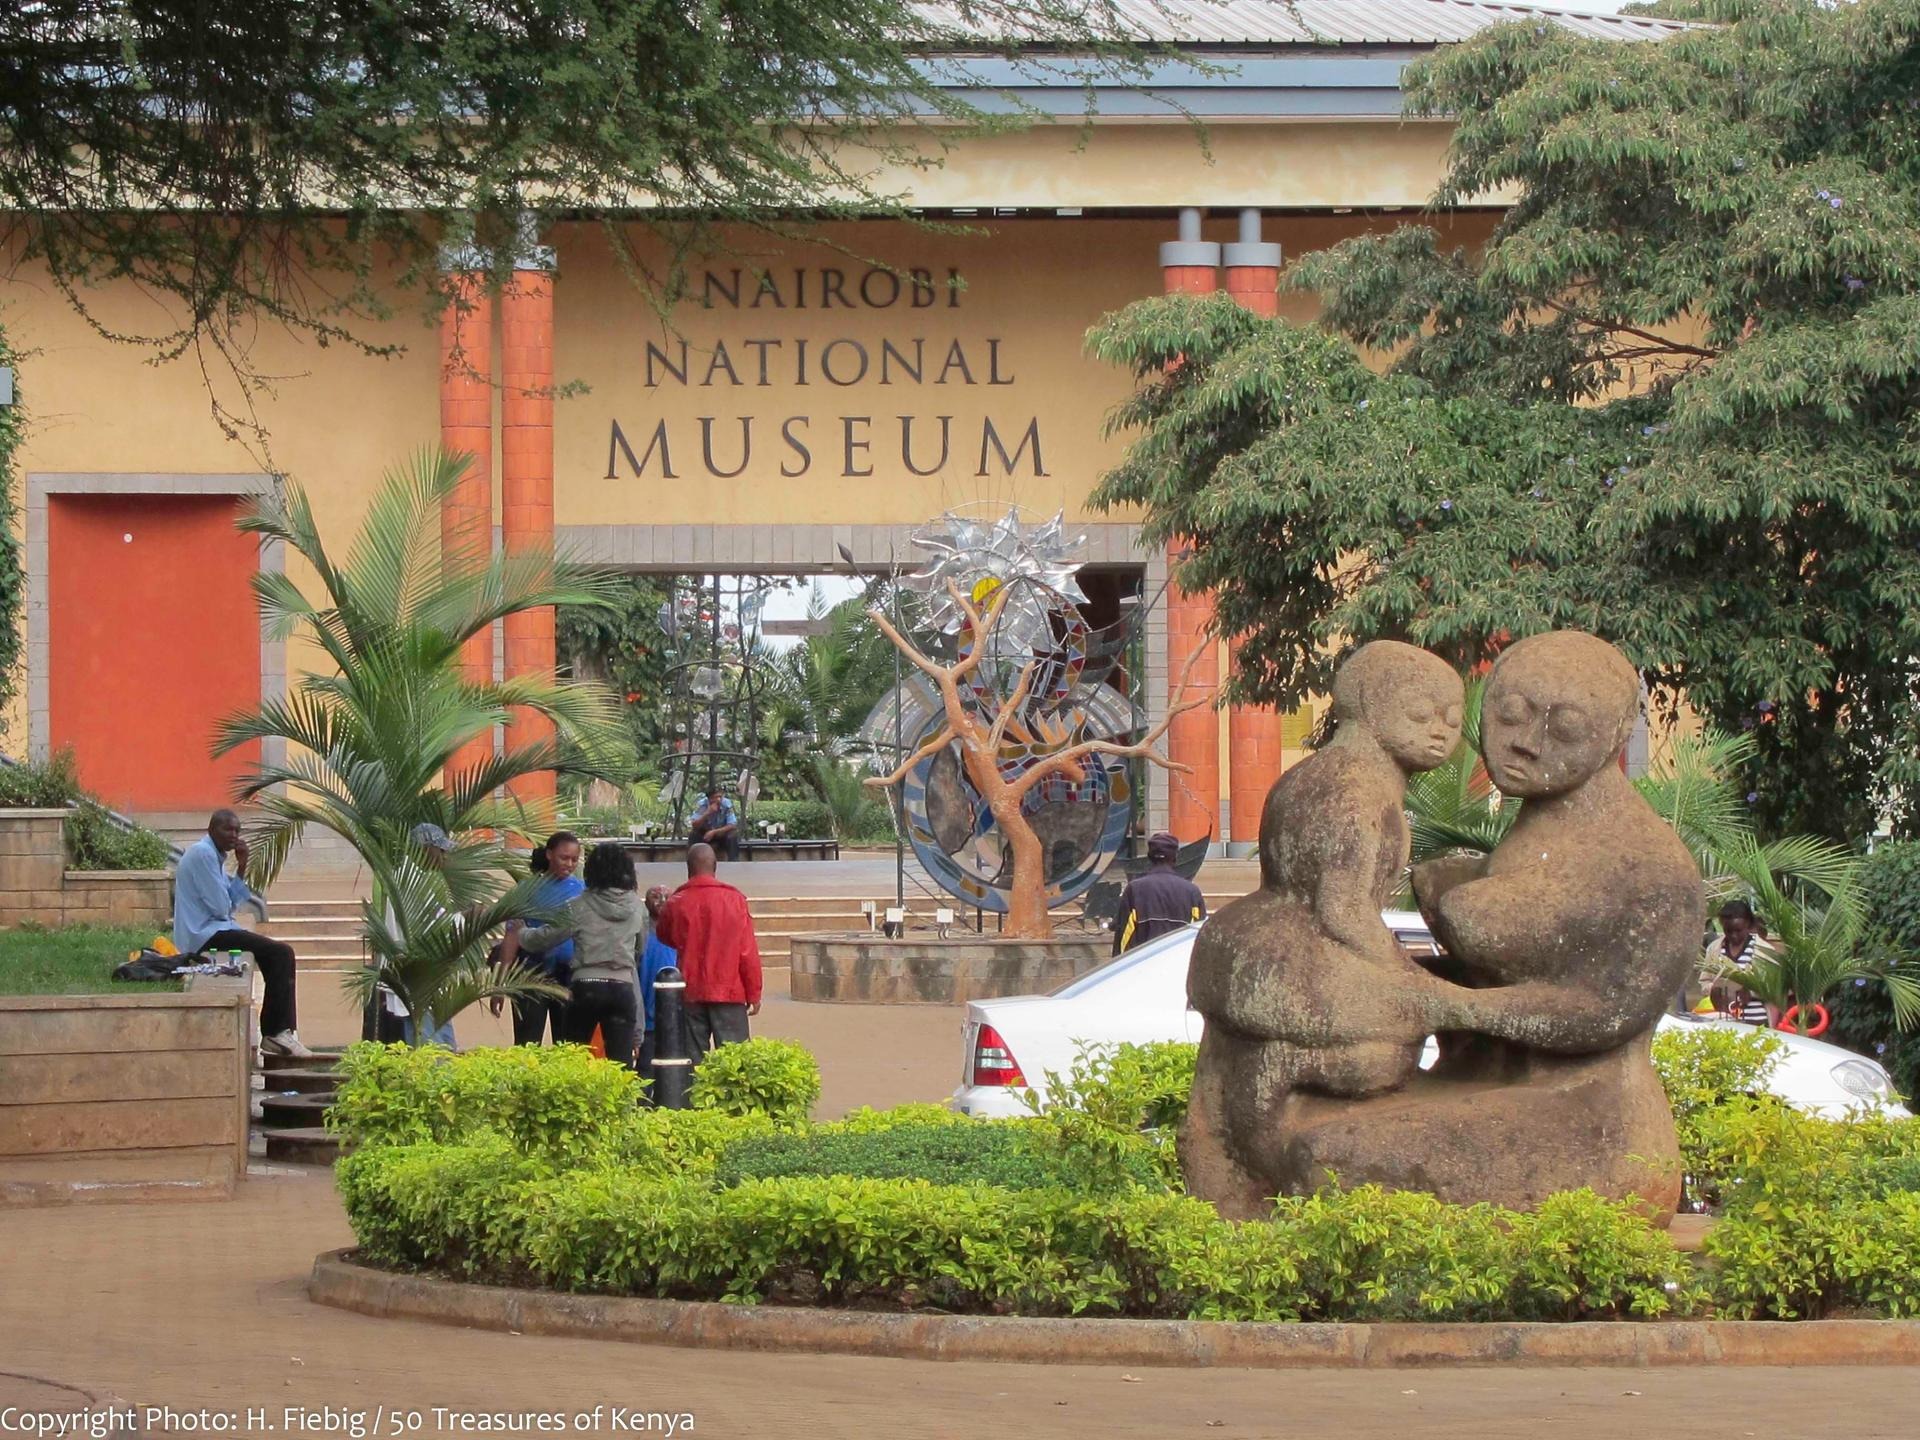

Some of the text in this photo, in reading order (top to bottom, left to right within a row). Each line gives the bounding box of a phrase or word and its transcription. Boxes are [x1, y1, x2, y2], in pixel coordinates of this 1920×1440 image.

[703, 268, 961, 310] NAIROBI
[644, 338, 1015, 387] NATIONAL
[604, 415, 1051, 480] MUSEUM
